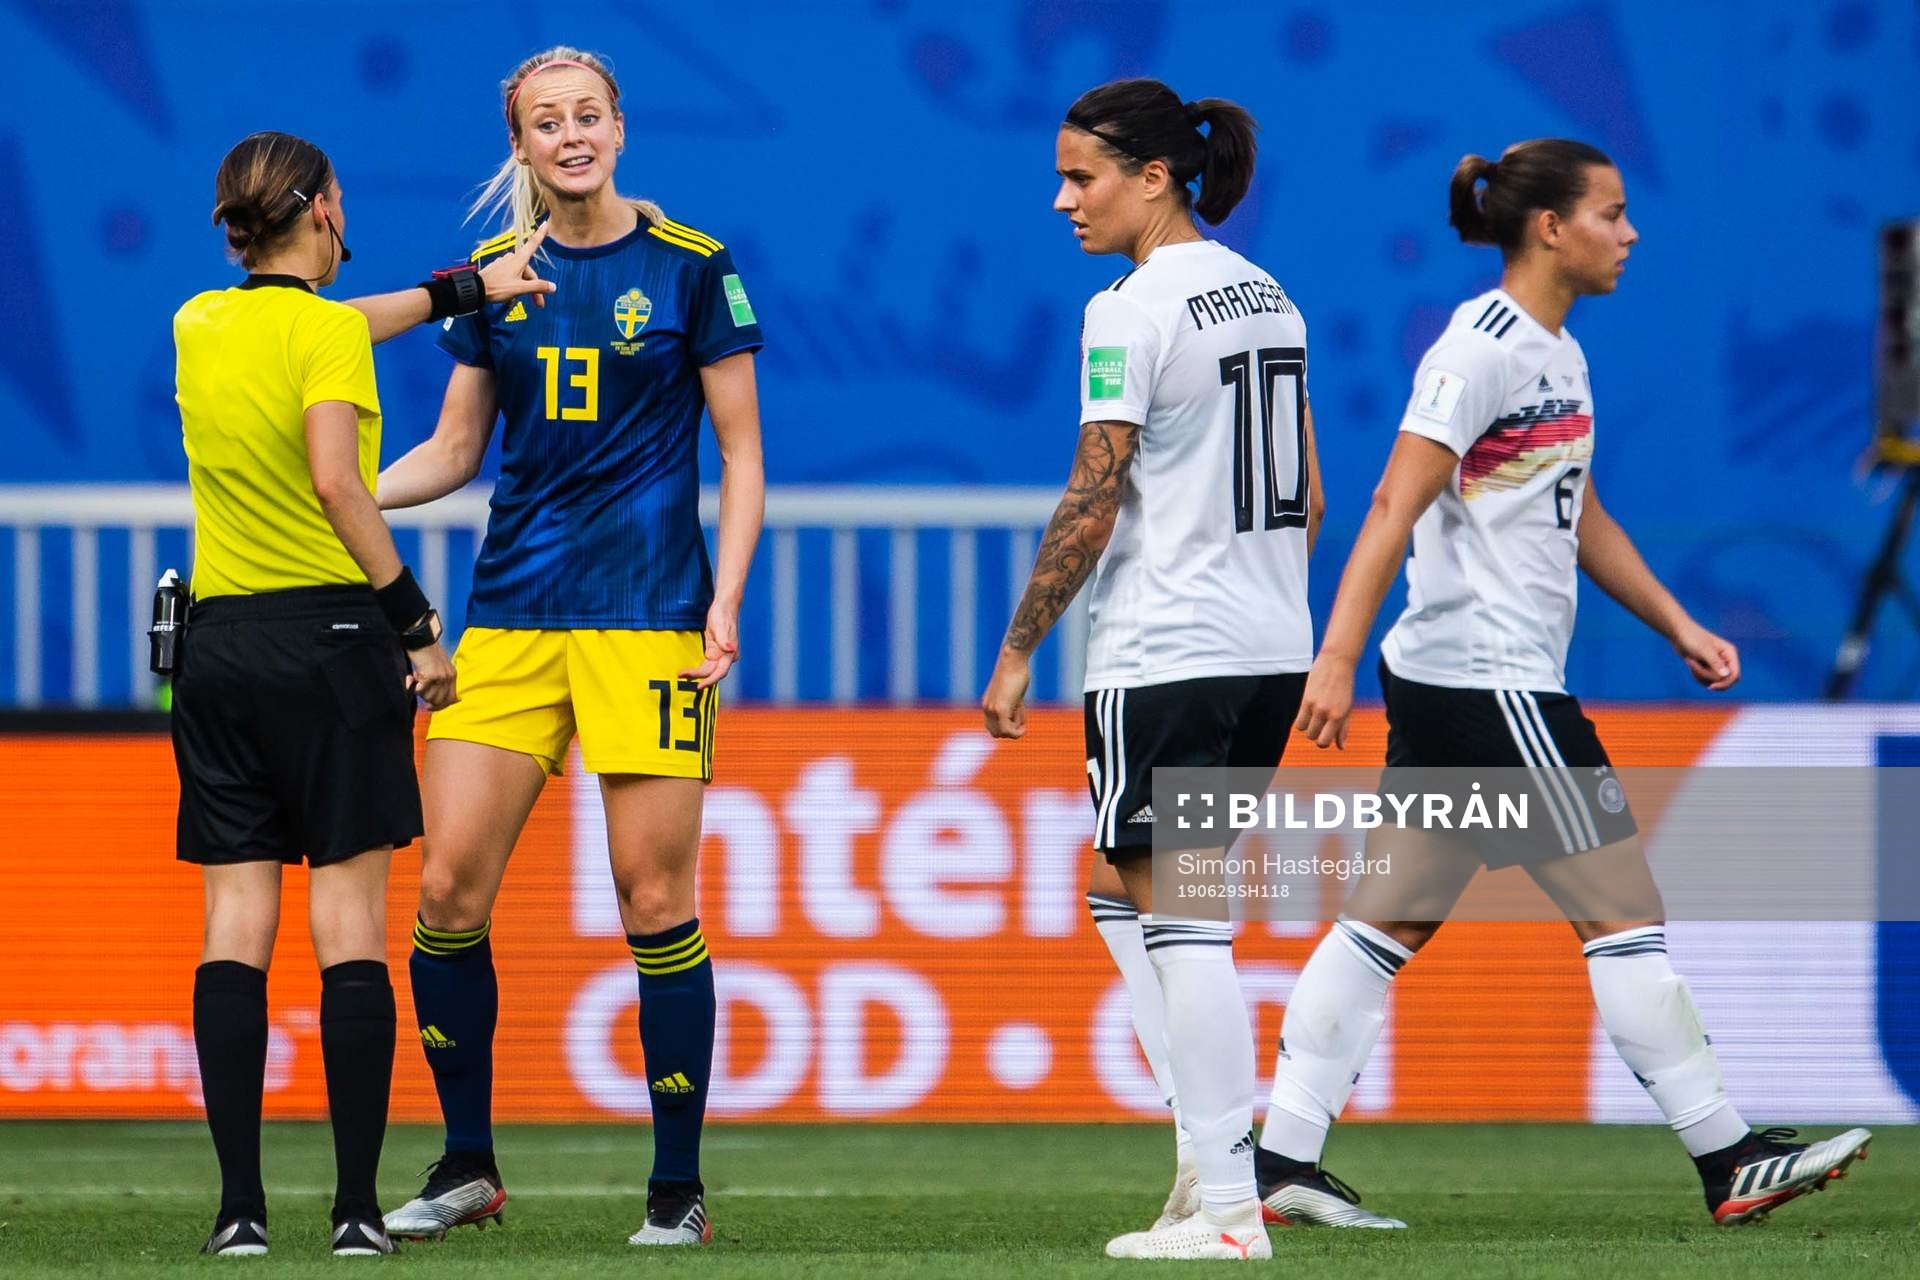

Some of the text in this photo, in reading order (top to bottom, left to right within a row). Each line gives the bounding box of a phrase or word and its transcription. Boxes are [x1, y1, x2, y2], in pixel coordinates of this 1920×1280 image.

[536, 346, 600, 421] 13
[1218, 346, 1310, 535] 10
[1554, 466, 1583, 530] 6
[648, 679, 702, 753] 13
[570, 732, 1376, 938] Intérm
[0, 1020, 297, 1107] orane
